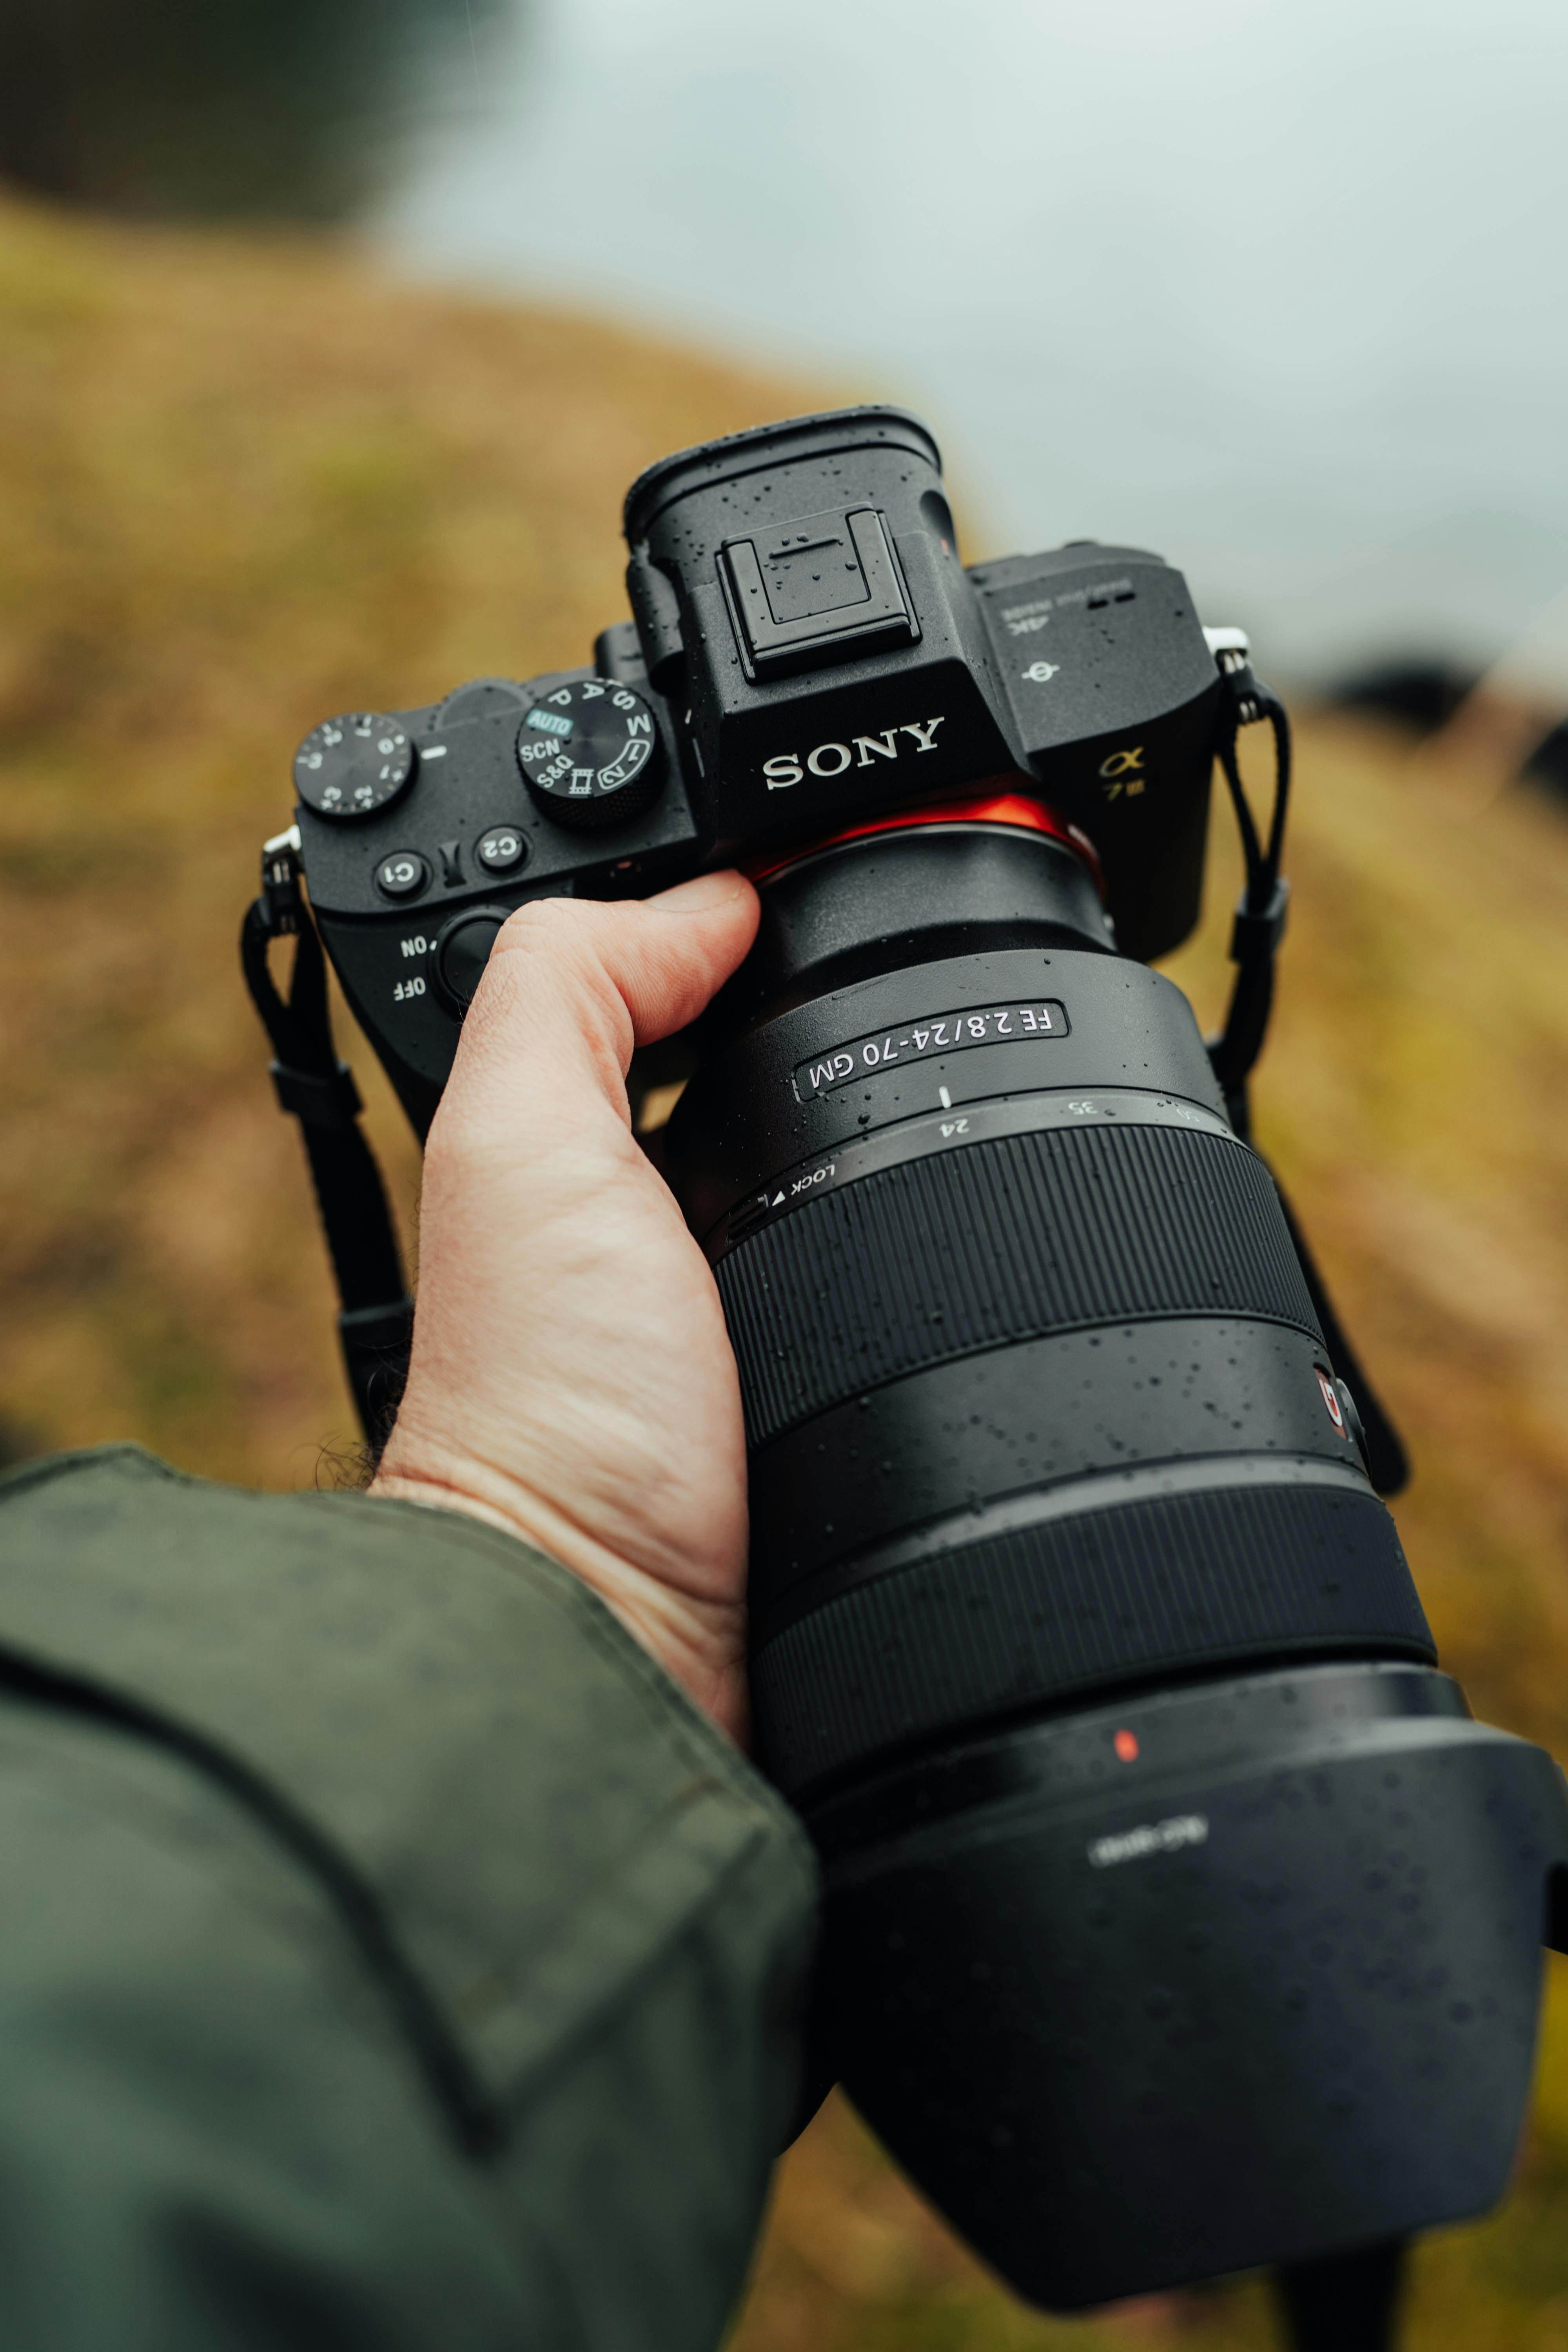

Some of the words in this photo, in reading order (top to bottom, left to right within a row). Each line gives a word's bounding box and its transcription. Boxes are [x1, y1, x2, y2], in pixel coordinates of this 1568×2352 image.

[548, 689, 572, 705] P
[582, 682, 605, 700] A
[612, 690, 636, 710] S
[528, 710, 570, 735] AUTO
[626, 713, 651, 737] M
[520, 738, 561, 762] SCN
[762, 716, 945, 791] SONY
[537, 754, 575, 788] S&Q
[602, 765, 626, 784] 2
[483, 836, 517, 858] C2
[384, 862, 414, 883] C1
[401, 936, 426, 958] ON
[394, 977, 426, 1001] OFF
[1019, 1009, 1052, 1031] FE
[862, 1012, 1013, 1065] 2.8/24-70
[809, 1053, 854, 1089] GM
[1068, 1102, 1098, 1115] 35
[939, 1118, 970, 1138] 24
[791, 1163, 835, 1196] LOCK
